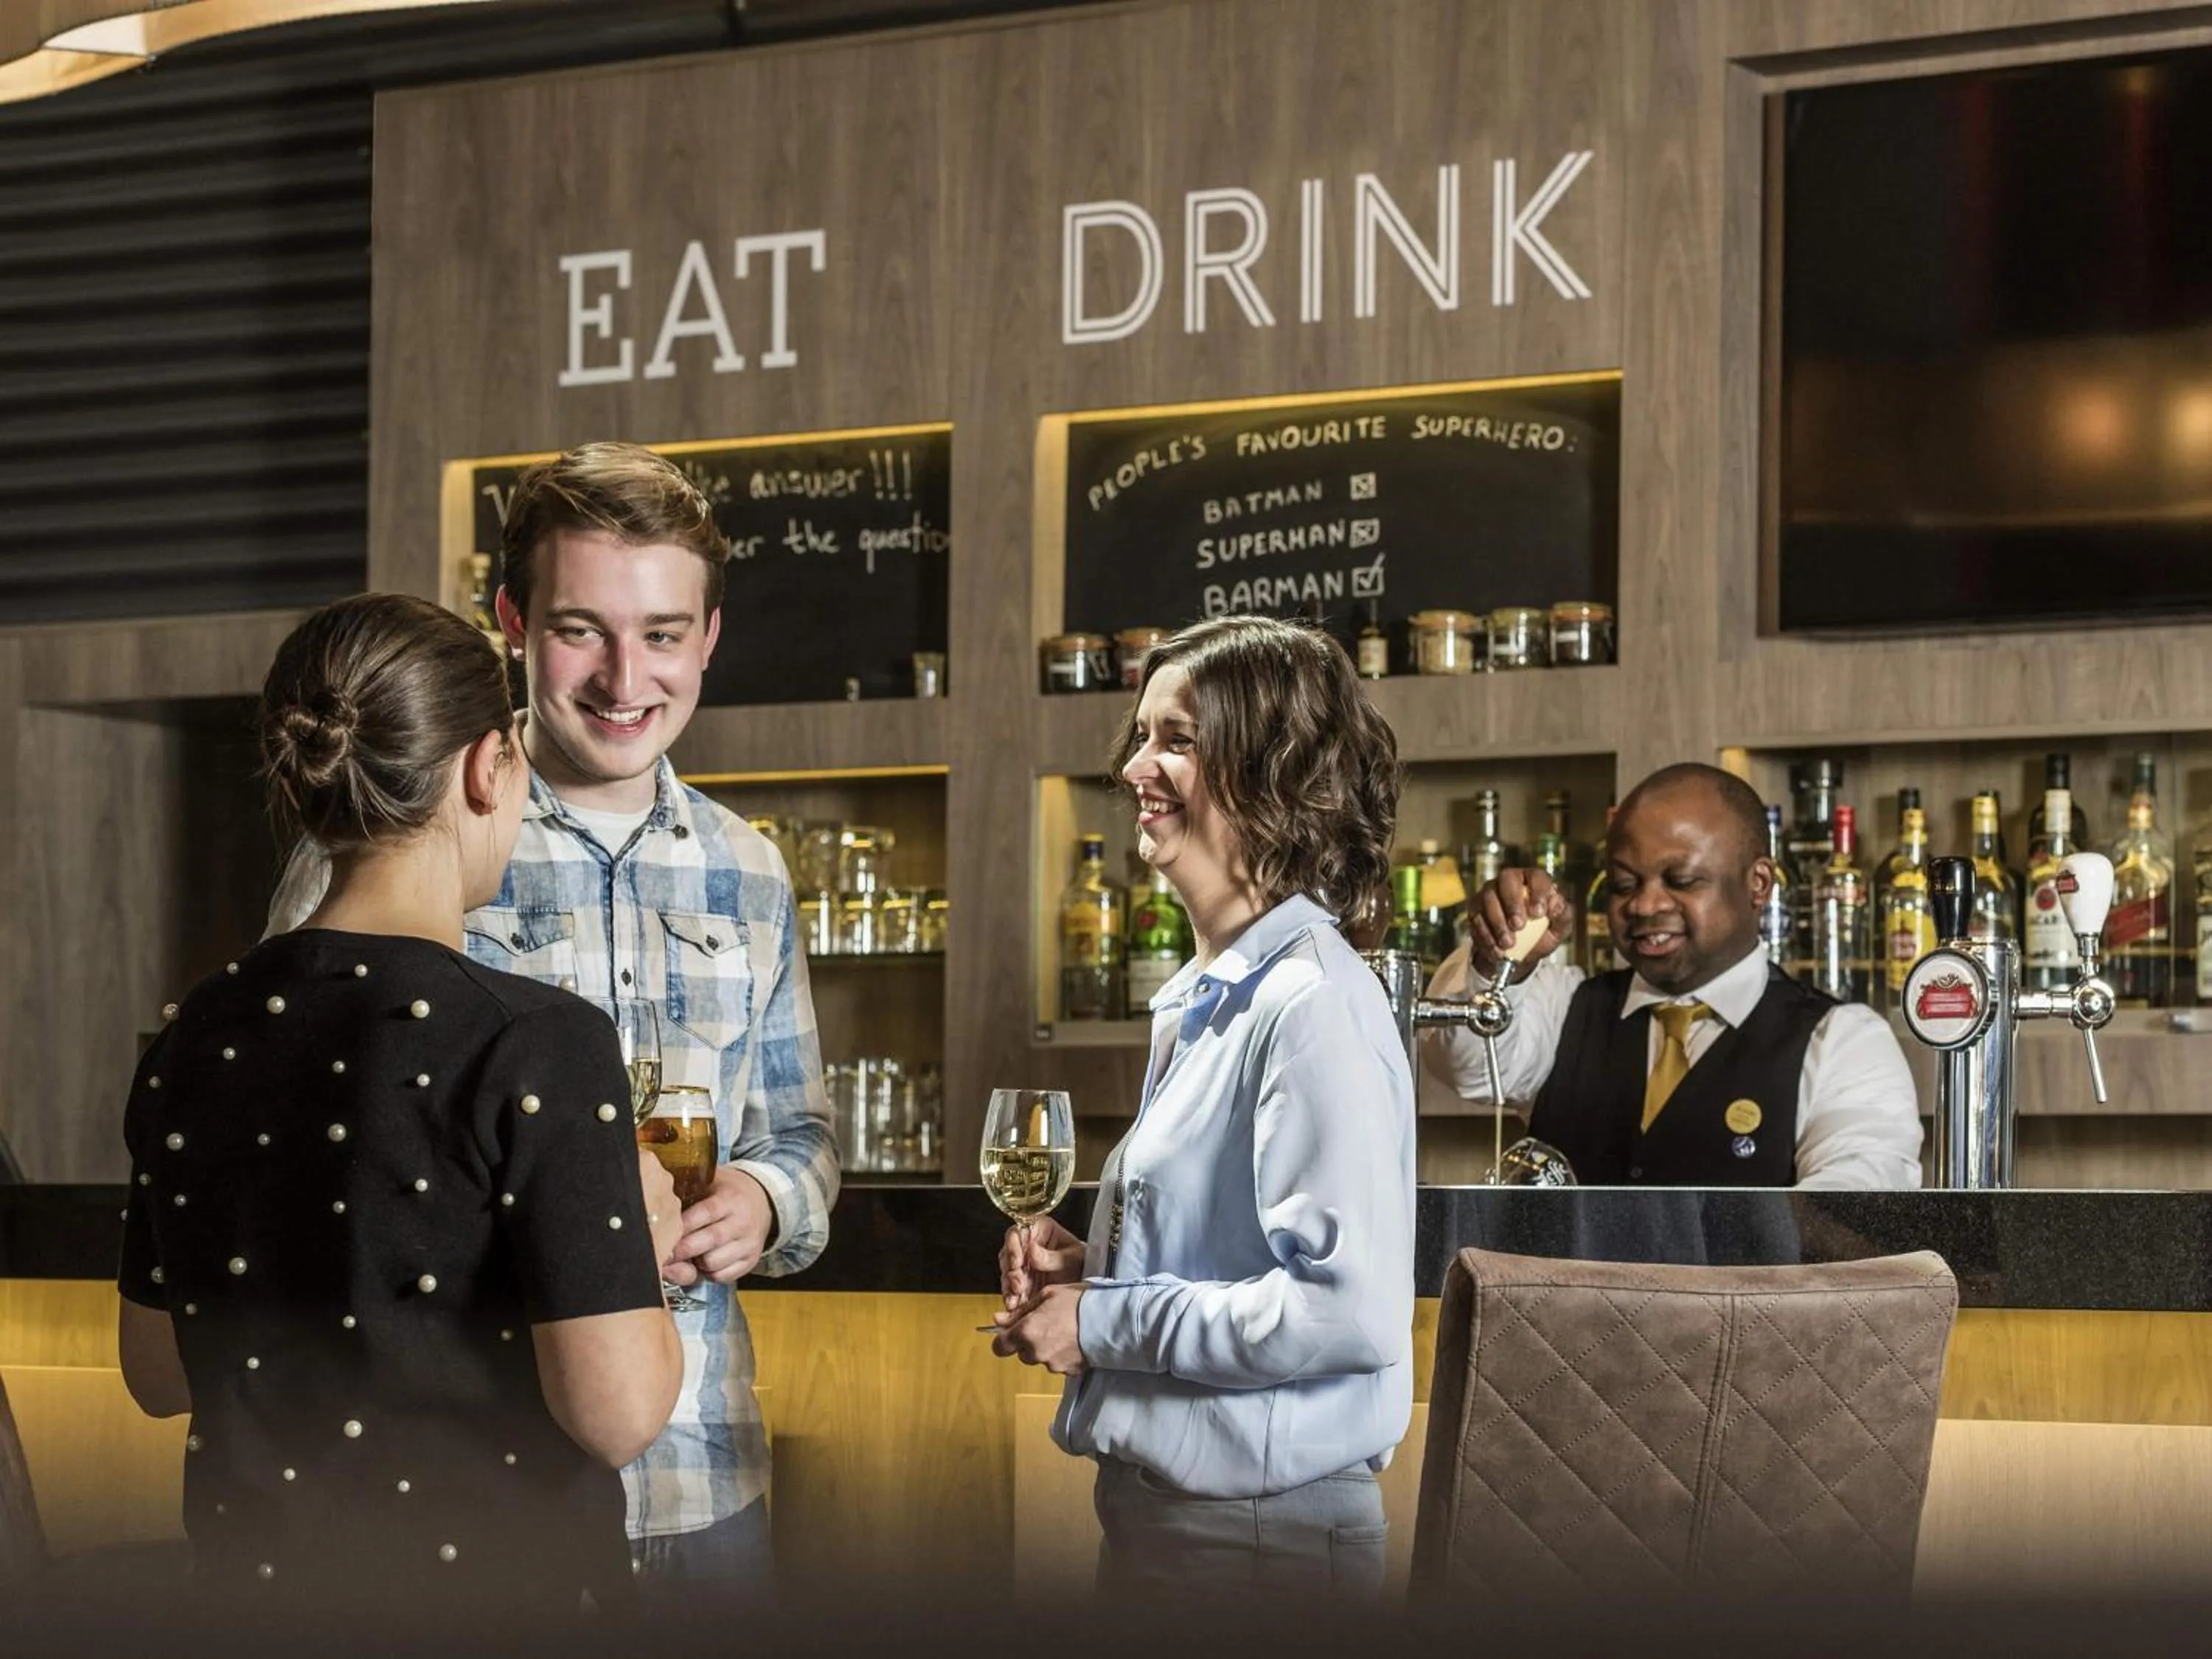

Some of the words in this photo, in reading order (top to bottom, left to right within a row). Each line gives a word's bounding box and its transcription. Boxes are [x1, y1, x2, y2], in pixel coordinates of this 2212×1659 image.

[1062, 150, 1594, 344] DRINK
[559, 229, 827, 386] EAT
[1088, 434, 1208, 512] PEOPLE'S
[1236, 415, 1387, 456] FAVOURITE
[1203, 479, 1322, 525] BATMAN
[782, 517, 841, 554] the
[858, 509, 950, 575] questio
[1203, 570, 1343, 620] BARMAN
